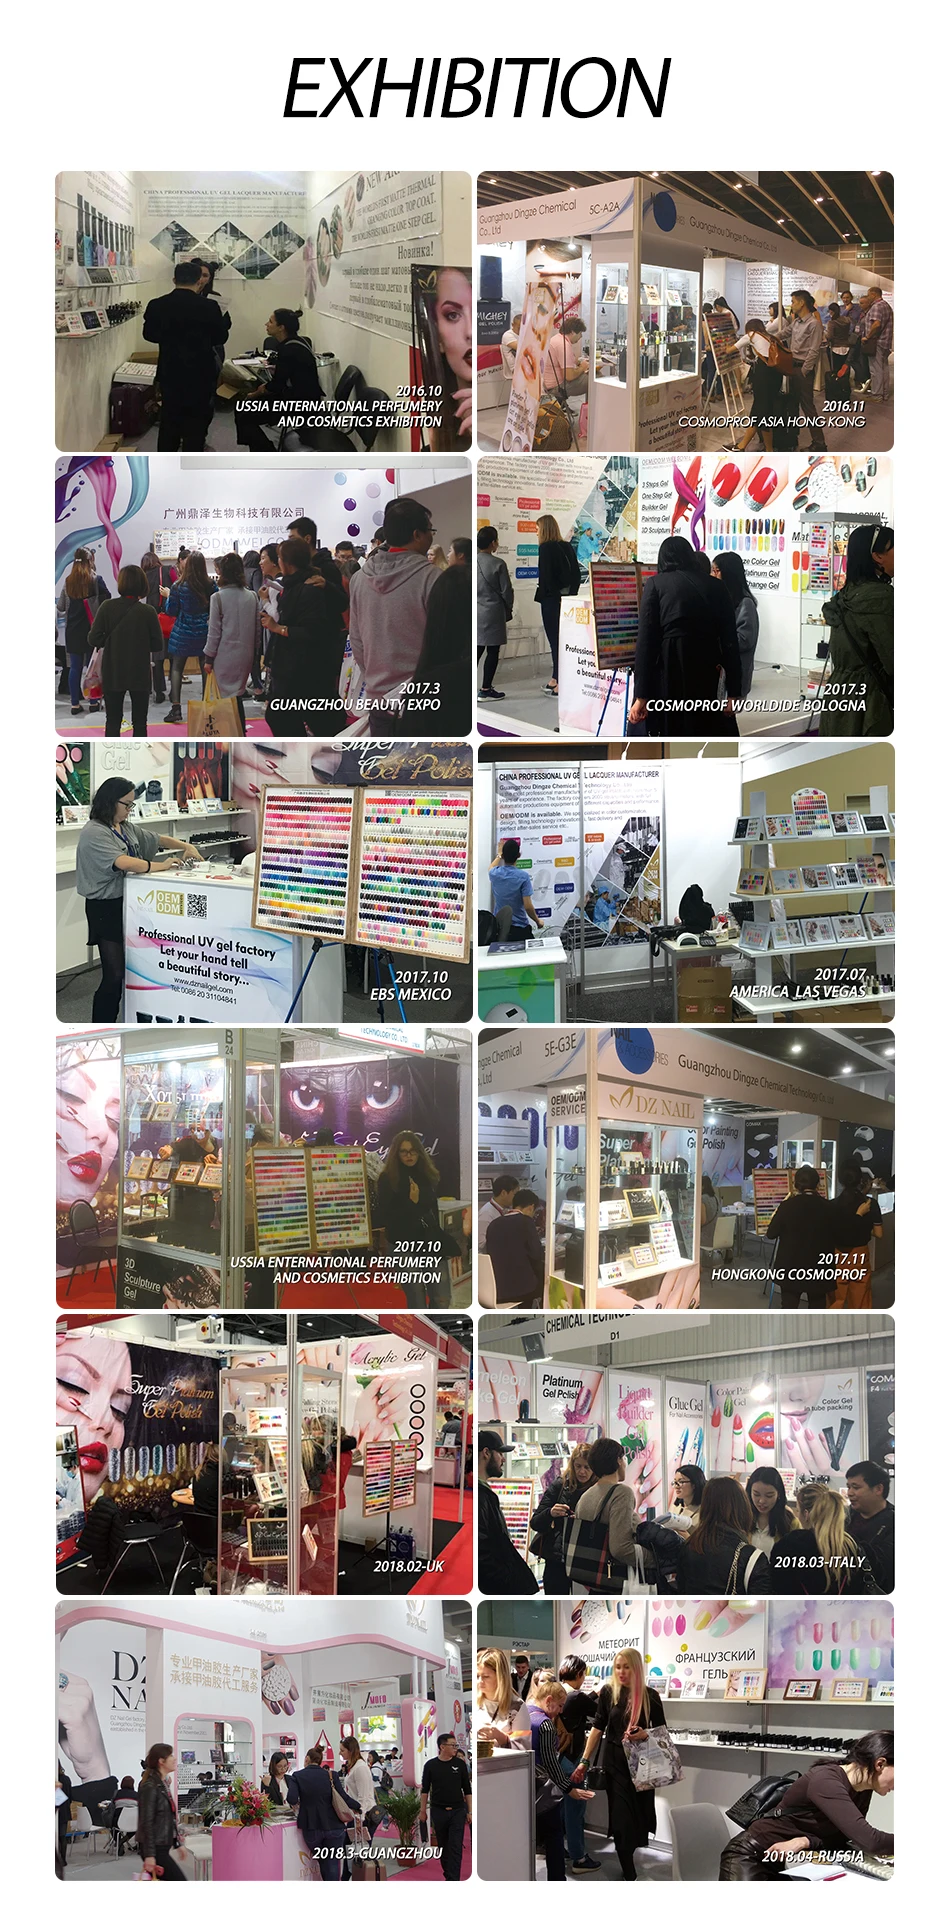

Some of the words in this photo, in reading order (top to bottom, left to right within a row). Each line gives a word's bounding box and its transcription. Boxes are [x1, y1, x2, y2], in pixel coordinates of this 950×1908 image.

[407, 174, 436, 197] THERMAL
[479, 211, 514, 224] Guangzhou
[514, 207, 537, 220] Dingze
[538, 199, 577, 215] Chemical
[589, 202, 620, 216] 5C-A2A
[408, 217, 421, 229] STEP
[690, 216, 725, 236] Guangzhou
[726, 228, 742, 243] Dingze
[492, 225, 502, 236] Ltd
[397, 241, 434, 260] Новинка!
[646, 480, 659, 489] Steps
[660, 480, 669, 488] Gel
[642, 492, 652, 500] One
[652, 492, 664, 501] Step
[163, 507, 305, 520] 广州鼎泽生物科技有限公司
[641, 504, 658, 512] Builder
[658, 503, 668, 511] Gel
[641, 514, 661, 524] Painting
[662, 515, 670, 523] Gel
[672, 526, 681, 534] Gel
[751, 557, 768, 566] Color
[768, 558, 780, 566] Gel
[769, 570, 780, 578] Gel
[768, 582, 780, 590] Gel
[577, 656, 587, 666] Let
[581, 668, 606, 681] beautiful
[101, 750, 131, 770] Gel
[358, 755, 404, 780] Gel
[408, 754, 473, 780] Polis
[499, 774, 518, 782] CHINA
[518, 772, 562, 782] PROFESSIONAL
[564, 772, 572, 780] UV
[589, 772, 616, 780] LACQUER
[616, 771, 660, 779] MANUFACTURER
[500, 784, 532, 792] Guangzhou
[532, 783, 551, 791] Dingze
[500, 812, 530, 820] OEM/ODM
[158, 892, 180, 904] OEM
[158, 902, 180, 914] ODM
[138, 926, 195, 945] Professional
[198, 935, 214, 948] UV
[216, 940, 232, 952] gel
[236, 942, 276, 961] factory
[160, 944, 175, 956] Let
[178, 949, 199, 961] your
[202, 952, 228, 966] hand
[230, 956, 248, 969] tell
[167, 960, 210, 978] beautiful
[214, 970, 249, 986] story...
[174, 977, 233, 994] www.dznailgel.com
[182, 986, 196, 995] 0086
[196, 989, 206, 997] 20
[206, 990, 236, 1004] 31104841
[226, 1028, 234, 1044] B
[225, 1045, 234, 1056] 24
[492, 1042, 522, 1062] Chemical
[544, 1033, 577, 1057] 5E-G3E
[482, 1071, 492, 1084] Ltd
[678, 1054, 732, 1079] Guangzhou
[733, 1068, 759, 1087] Dingze
[760, 1076, 788, 1093] Chemical
[788, 1084, 819, 1103] Technology
[551, 1090, 586, 1106] OEM/ODM
[551, 1103, 586, 1117] SERVICE
[636, 1095, 658, 1115] DZ
[661, 1100, 696, 1119] NAIL
[710, 1125, 739, 1140] Painting
[600, 1134, 636, 1154] Super
[702, 1138, 726, 1150] Polish
[125, 1258, 136, 1269] 3D
[124, 1272, 161, 1292] Sculpture
[124, 1286, 137, 1299] Gel
[546, 1314, 585, 1334] CHEMICAL
[610, 1331, 620, 1340] D1
[354, 1350, 398, 1367] Acrylic
[404, 1347, 428, 1362] Gel
[542, 1374, 583, 1388] Platinum
[124, 1374, 167, 1402] Super
[542, 1388, 556, 1398] Gel
[557, 1390, 580, 1400] Polish
[716, 1388, 736, 1397] Color
[669, 1396, 689, 1411] Glue
[690, 1398, 704, 1412] Gel
[734, 1398, 746, 1407] Gel
[842, 1397, 852, 1405] Gel
[142, 1399, 169, 1418] Gel
[170, 1400, 203, 1419] Polish
[618, 1405, 654, 1421] Builder
[826, 1404, 853, 1414] packing
[624, 1446, 652, 1460] Polish
[598, 1637, 640, 1650] МЕТЕОРИТ
[675, 1648, 756, 1664] ФРАНЦУЗСКИЙ
[170, 1653, 258, 1681] 专业甲油胶生产厂家
[702, 1668, 728, 1680] ГЕЛЬ
[170, 1670, 258, 1694] 承接甲油胶代工服务
